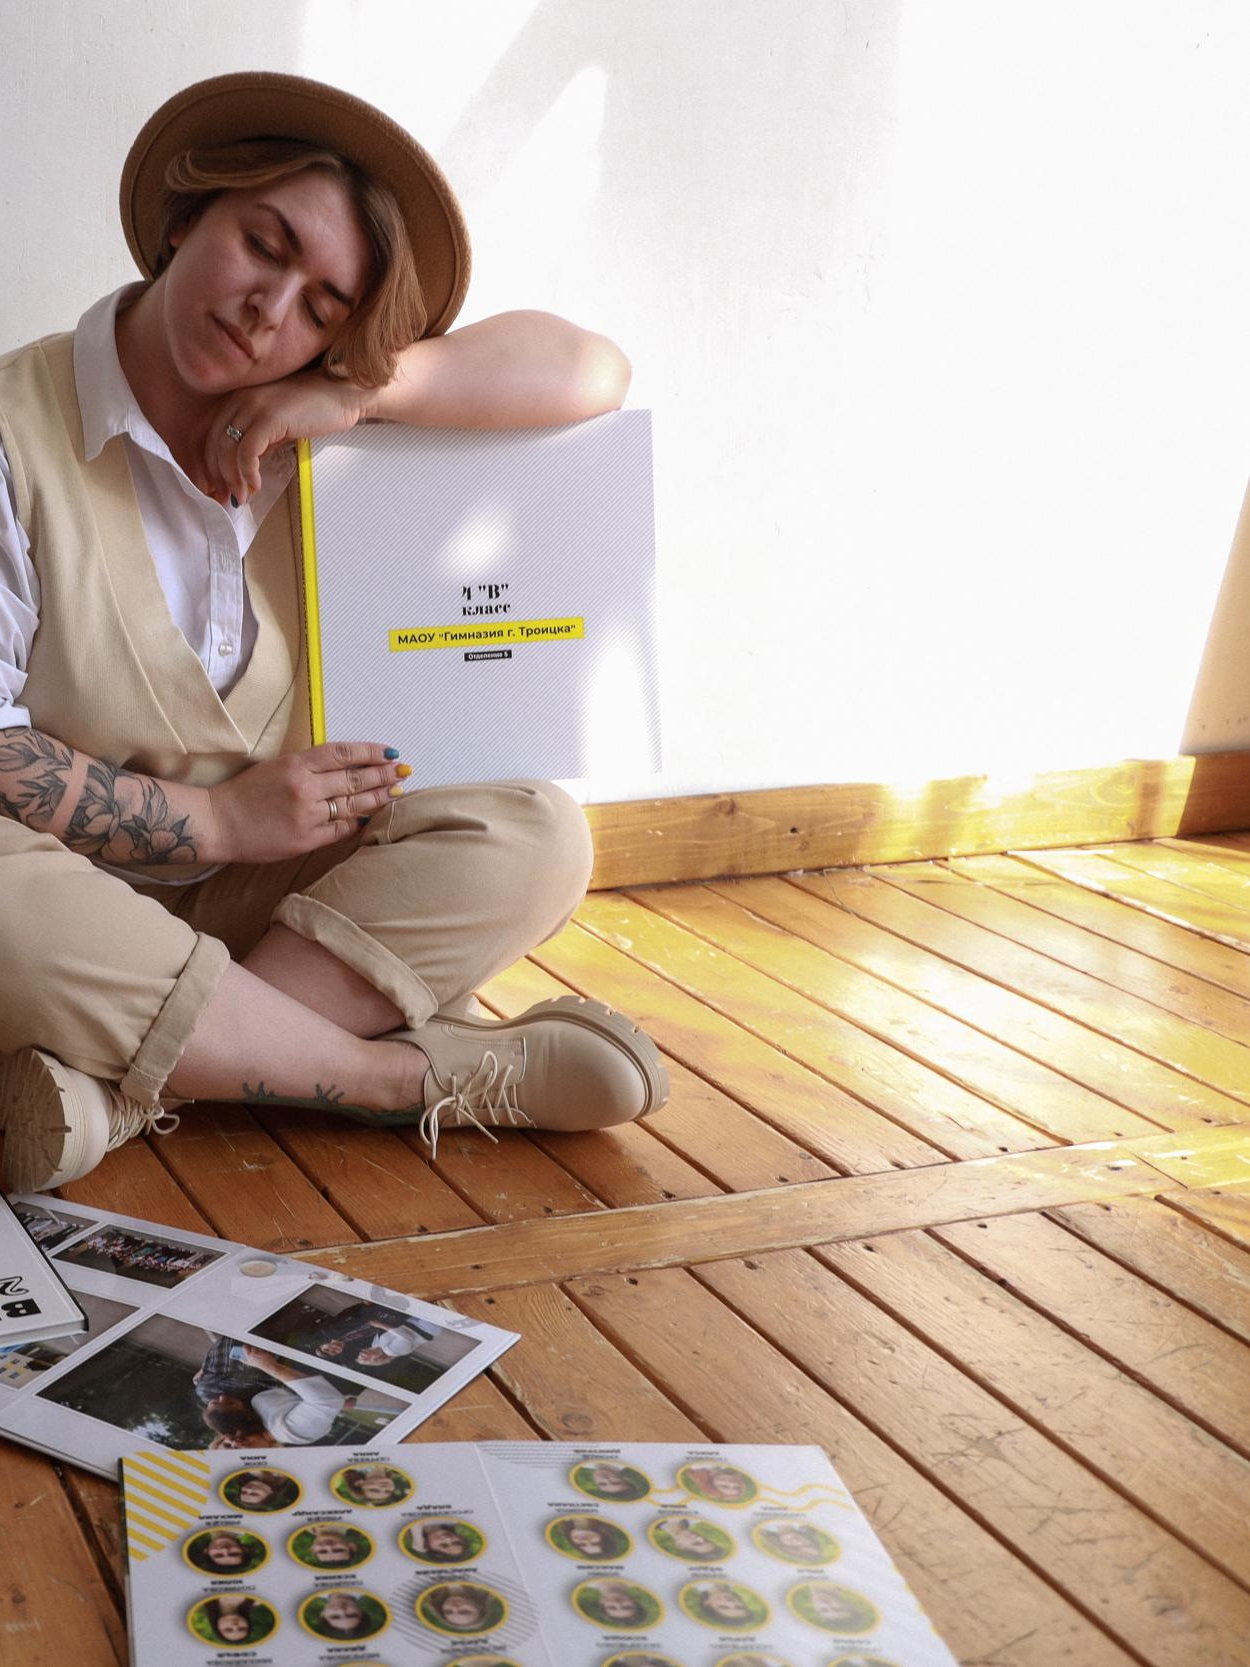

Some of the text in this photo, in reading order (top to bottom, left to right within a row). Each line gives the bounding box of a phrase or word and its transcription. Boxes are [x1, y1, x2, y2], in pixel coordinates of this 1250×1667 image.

[462, 604, 511, 616] класс
[397, 624, 576, 645] МАОУ "Гимназия г. Троицка"
